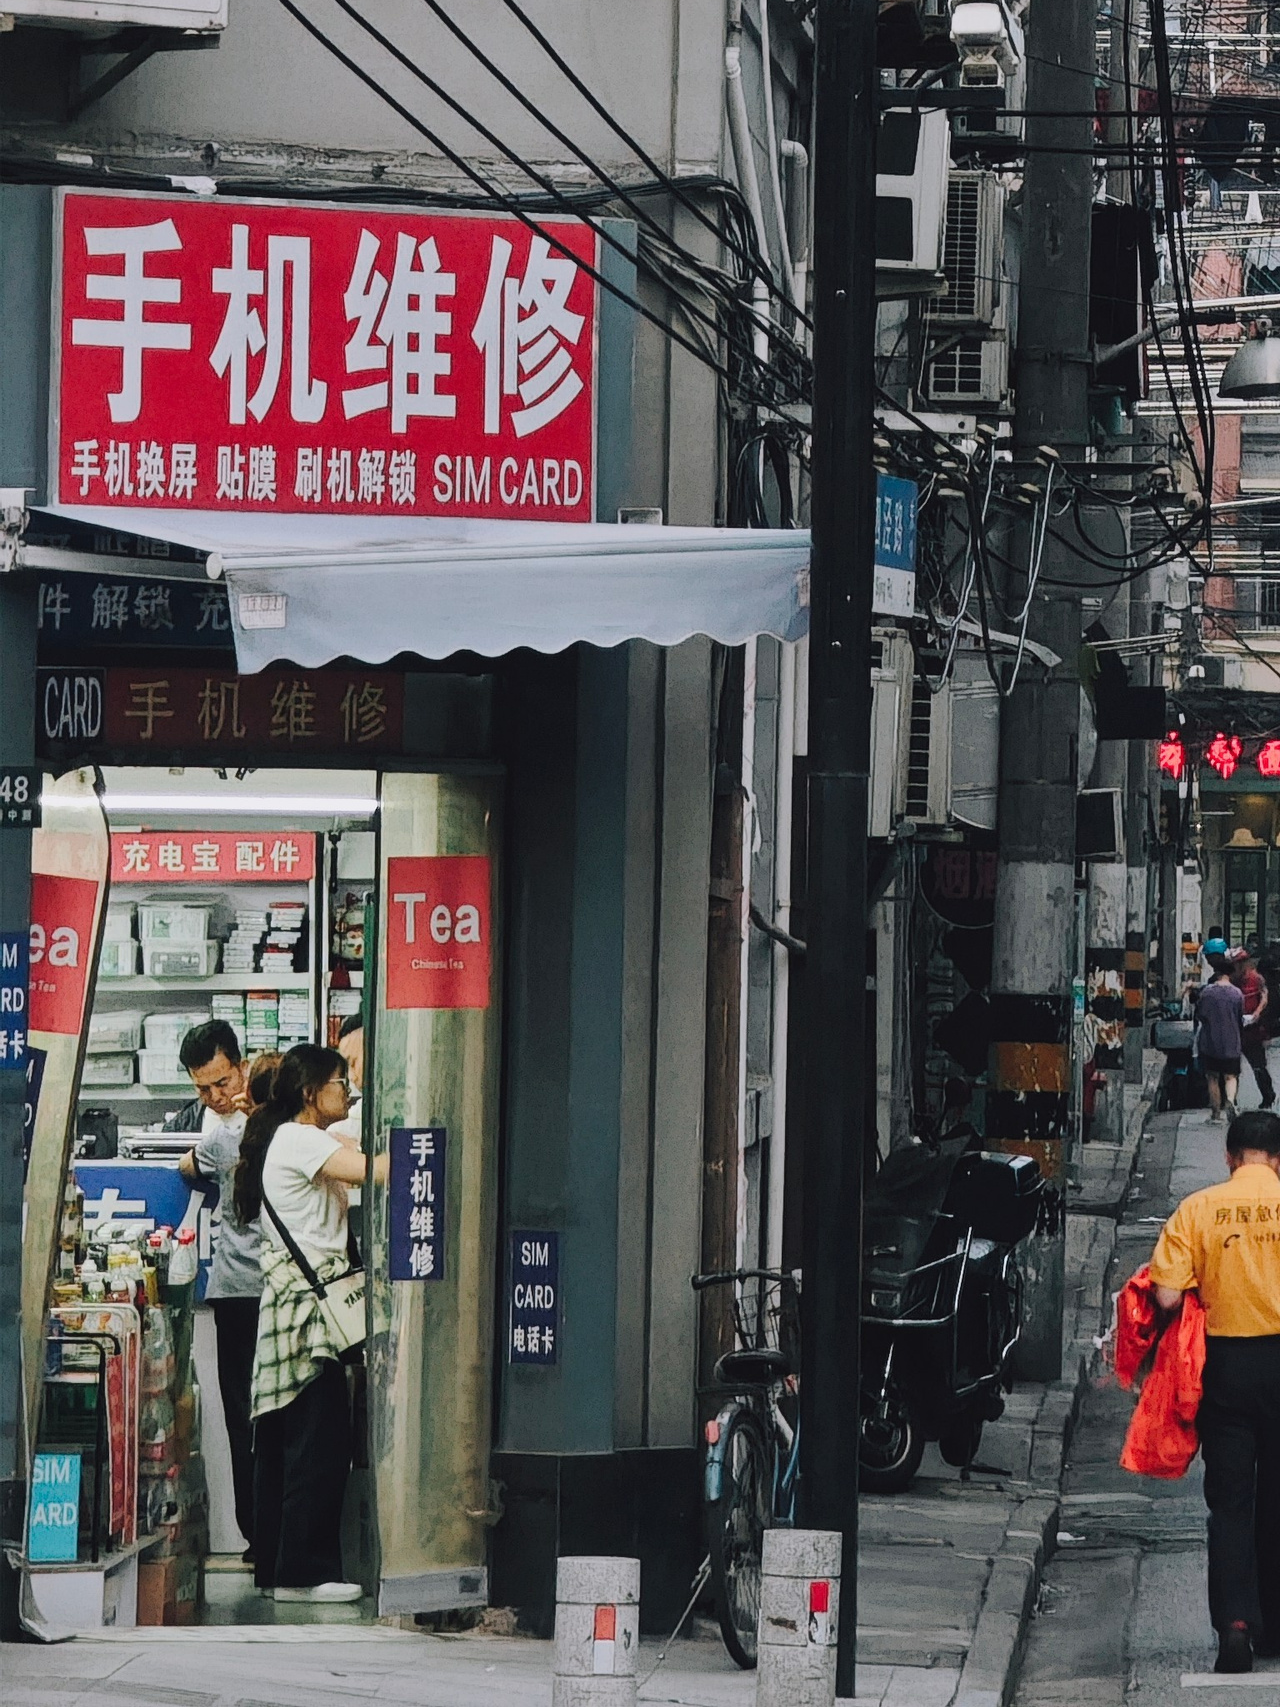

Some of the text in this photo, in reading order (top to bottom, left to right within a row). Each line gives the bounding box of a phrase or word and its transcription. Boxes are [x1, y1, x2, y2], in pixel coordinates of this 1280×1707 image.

[71, 217, 586, 439] 手机维修
[71, 439, 583, 508] 手机换屏 贴膜 刷机解锁 SIM CARD
[91, 581, 175, 631] 解锁
[45, 676, 101, 739] CARD
[125, 679, 389, 744] 手机维修
[122, 838, 301, 874] 充电宝 配件
[394, 892, 482, 945] Tea
[408, 1132, 436, 1278] 手机维修
[520, 1241, 550, 1267] SIM
[514, 1283, 555, 1309] CARD
[513, 1326, 555, 1356] 电话卡
